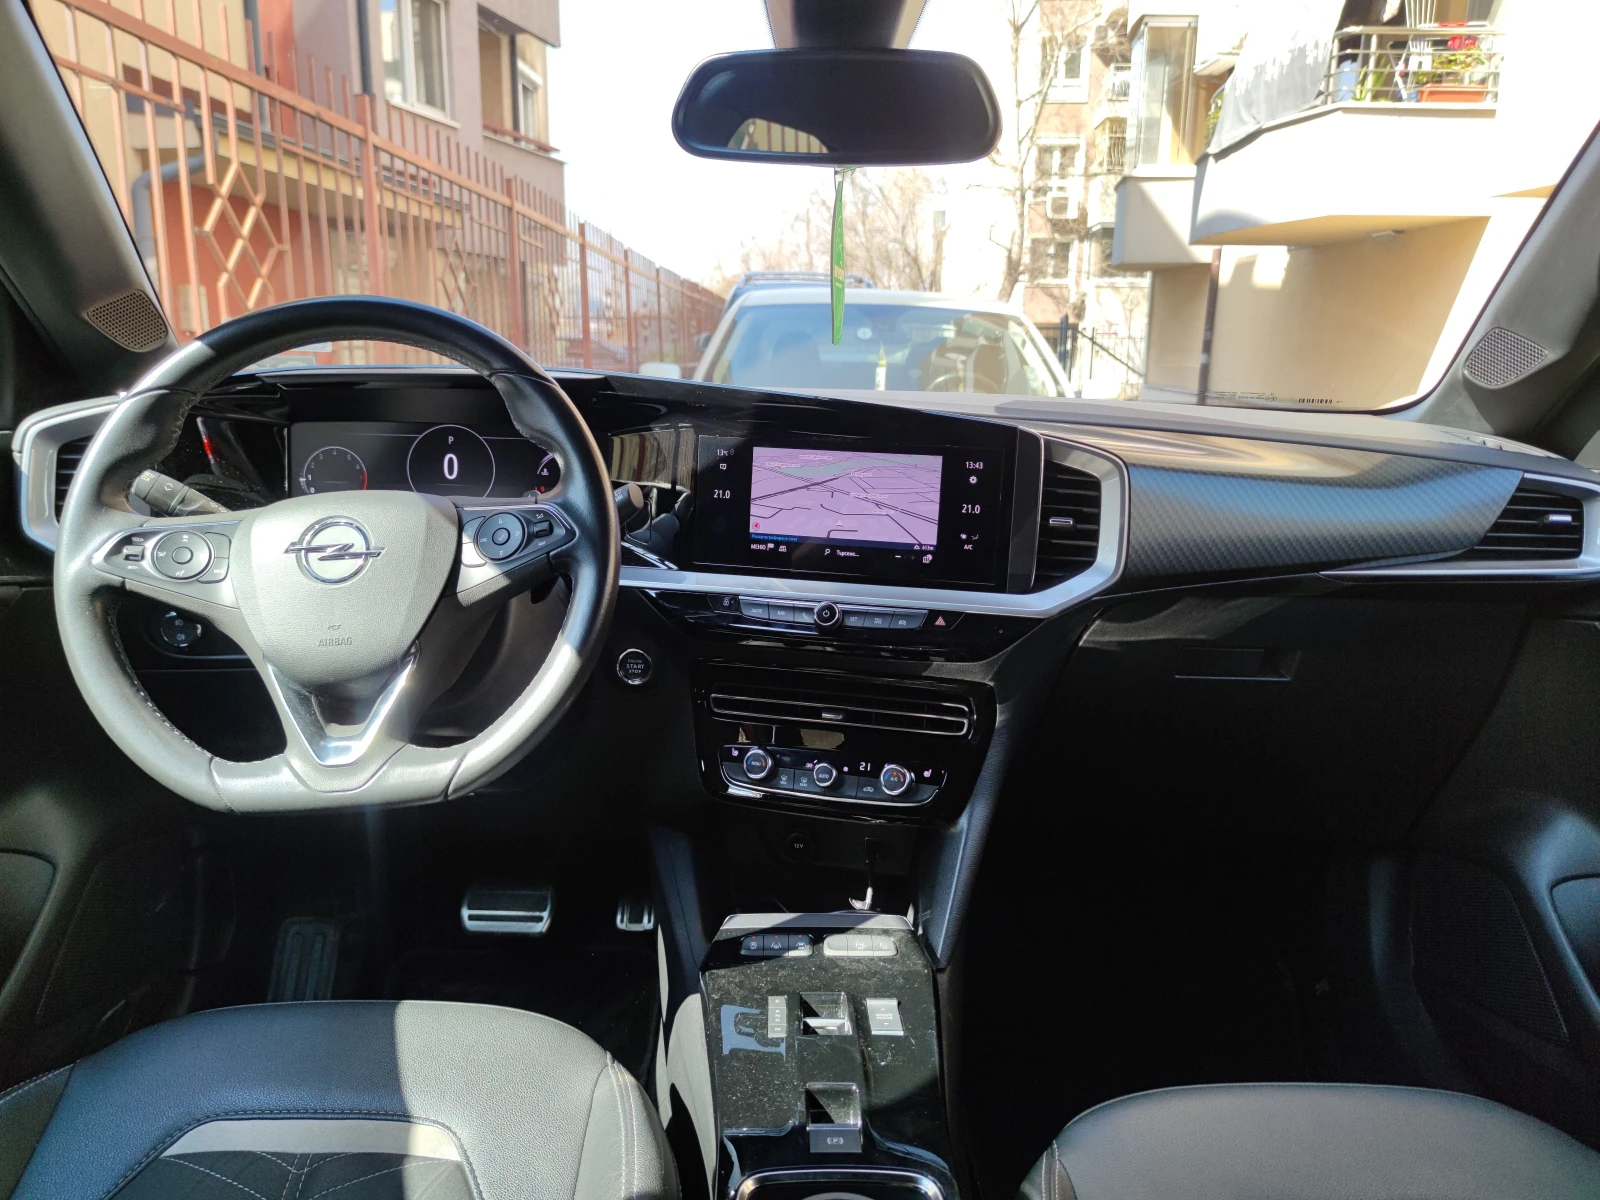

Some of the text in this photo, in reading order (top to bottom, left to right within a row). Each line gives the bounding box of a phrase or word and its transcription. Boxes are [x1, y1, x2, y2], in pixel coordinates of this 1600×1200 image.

[448, 436, 454, 444] P
[443, 453, 459, 480] 0
[965, 461, 984, 469] 13:43
[713, 489, 731, 499] 21.0
[961, 504, 981, 514] 21.0
[318, 637, 353, 647] AIRBAG
[859, 762, 871, 771] 21
